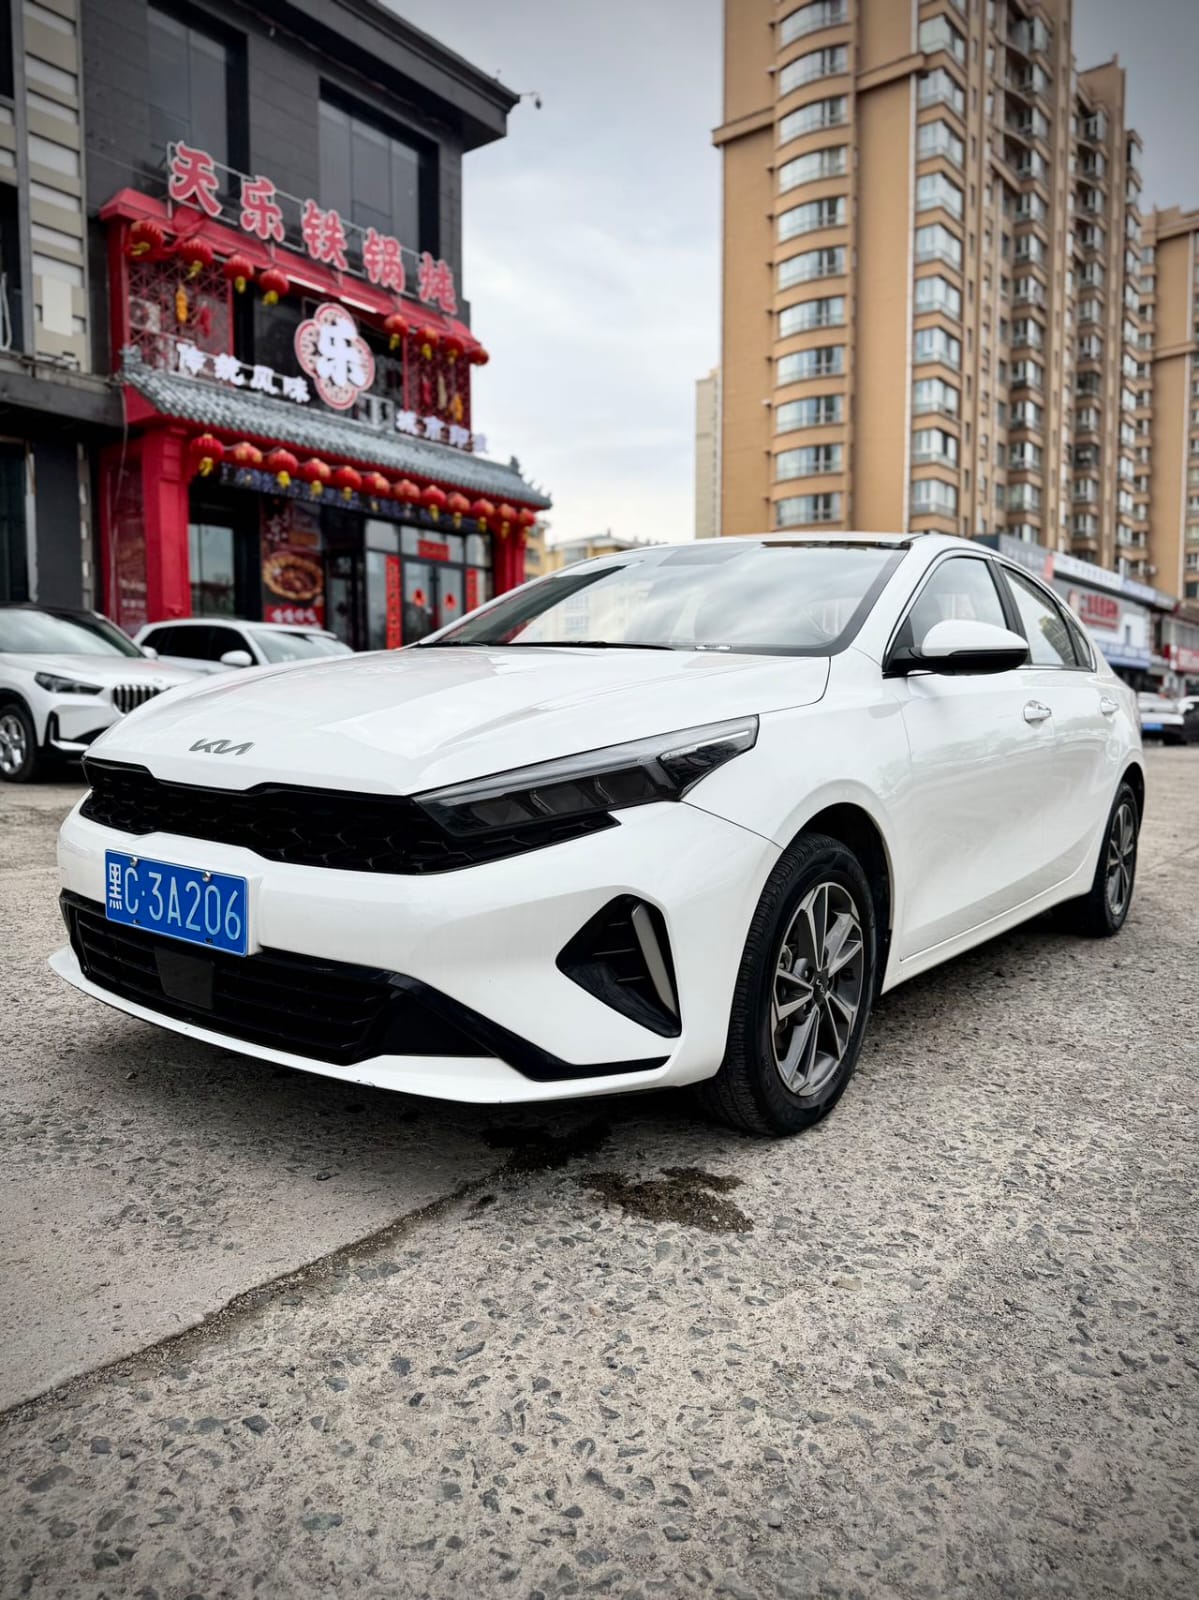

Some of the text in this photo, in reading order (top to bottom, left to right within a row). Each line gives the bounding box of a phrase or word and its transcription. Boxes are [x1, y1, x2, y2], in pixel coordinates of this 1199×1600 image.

[170, 142, 458, 315] 天乐铁锅炖
[317, 317, 366, 387] 乐
